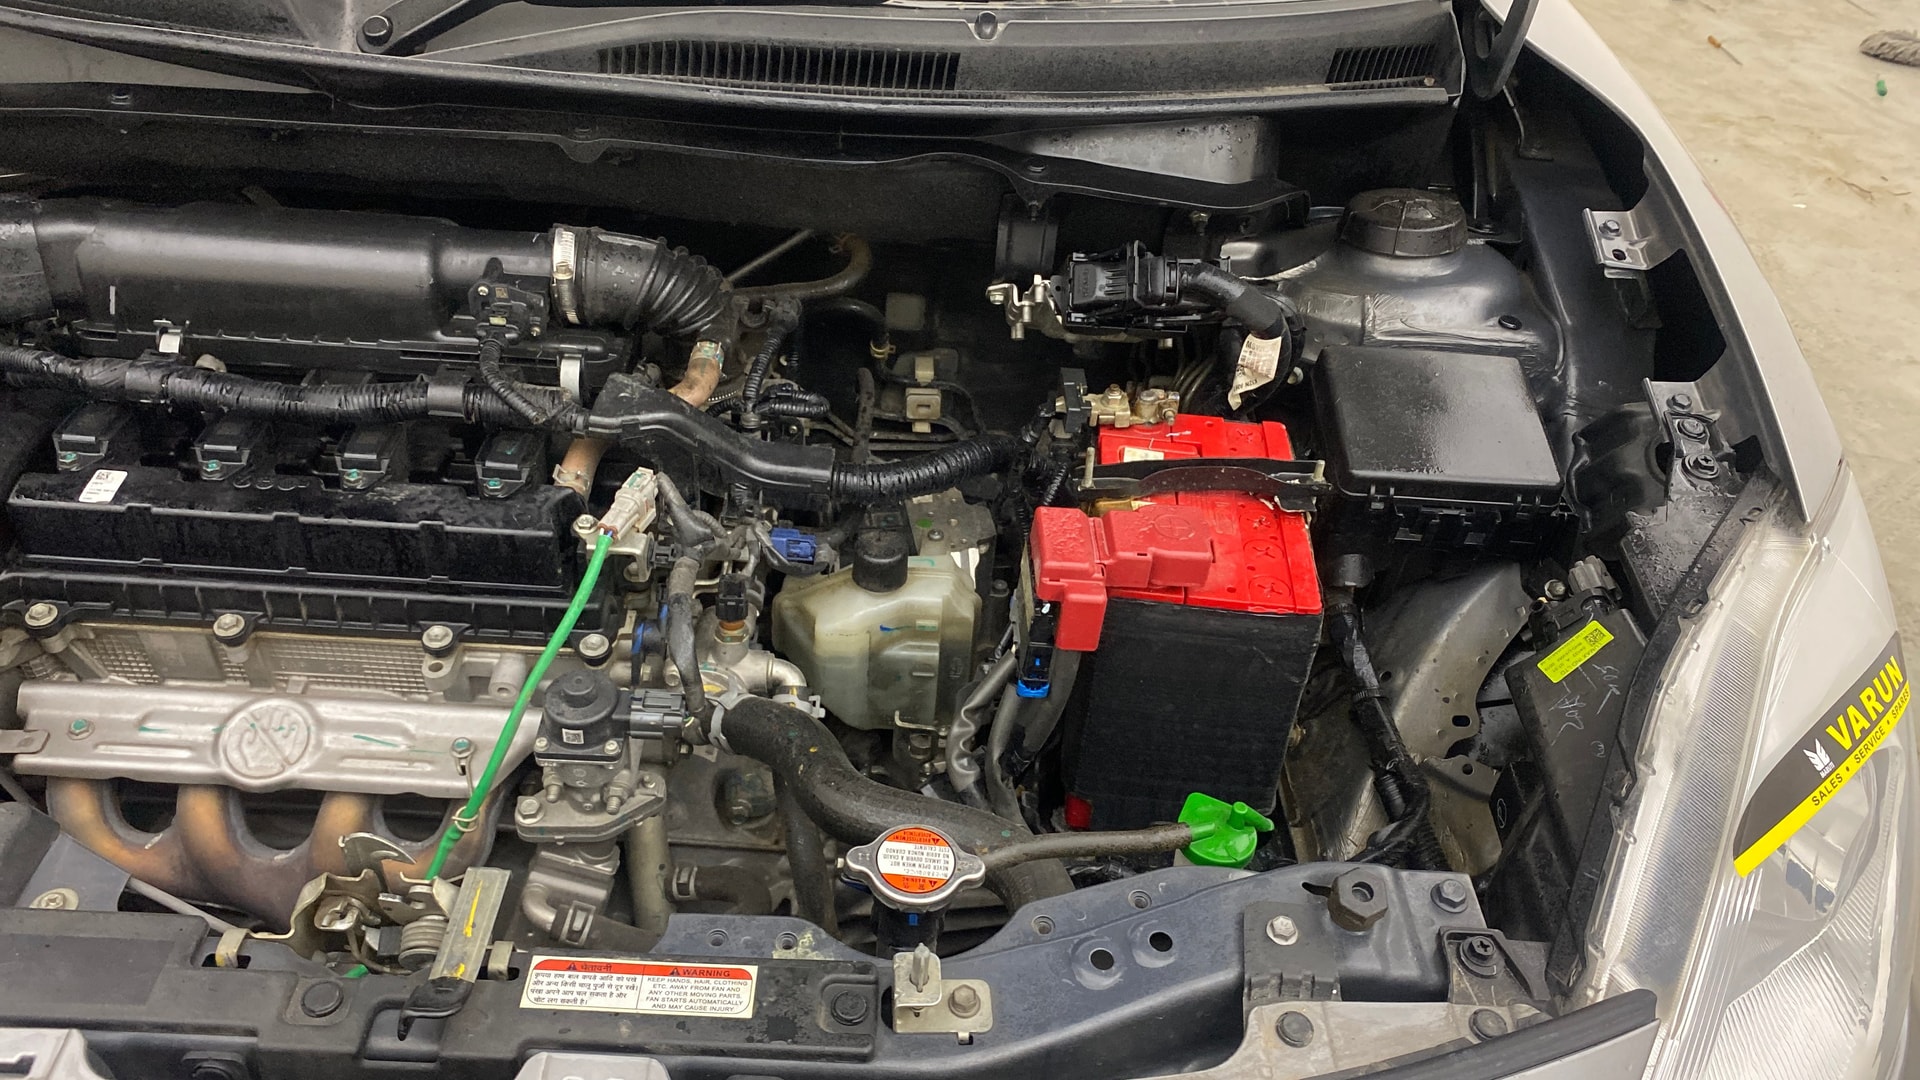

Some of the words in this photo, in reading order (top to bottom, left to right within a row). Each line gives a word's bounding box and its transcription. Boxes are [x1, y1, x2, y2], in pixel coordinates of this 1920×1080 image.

[1811, 773, 1843, 806] SALES
[1854, 726, 1885, 763] SERVICE
[1892, 688, 1909, 718] SPARES
[1826, 655, 1903, 751] VARUN
